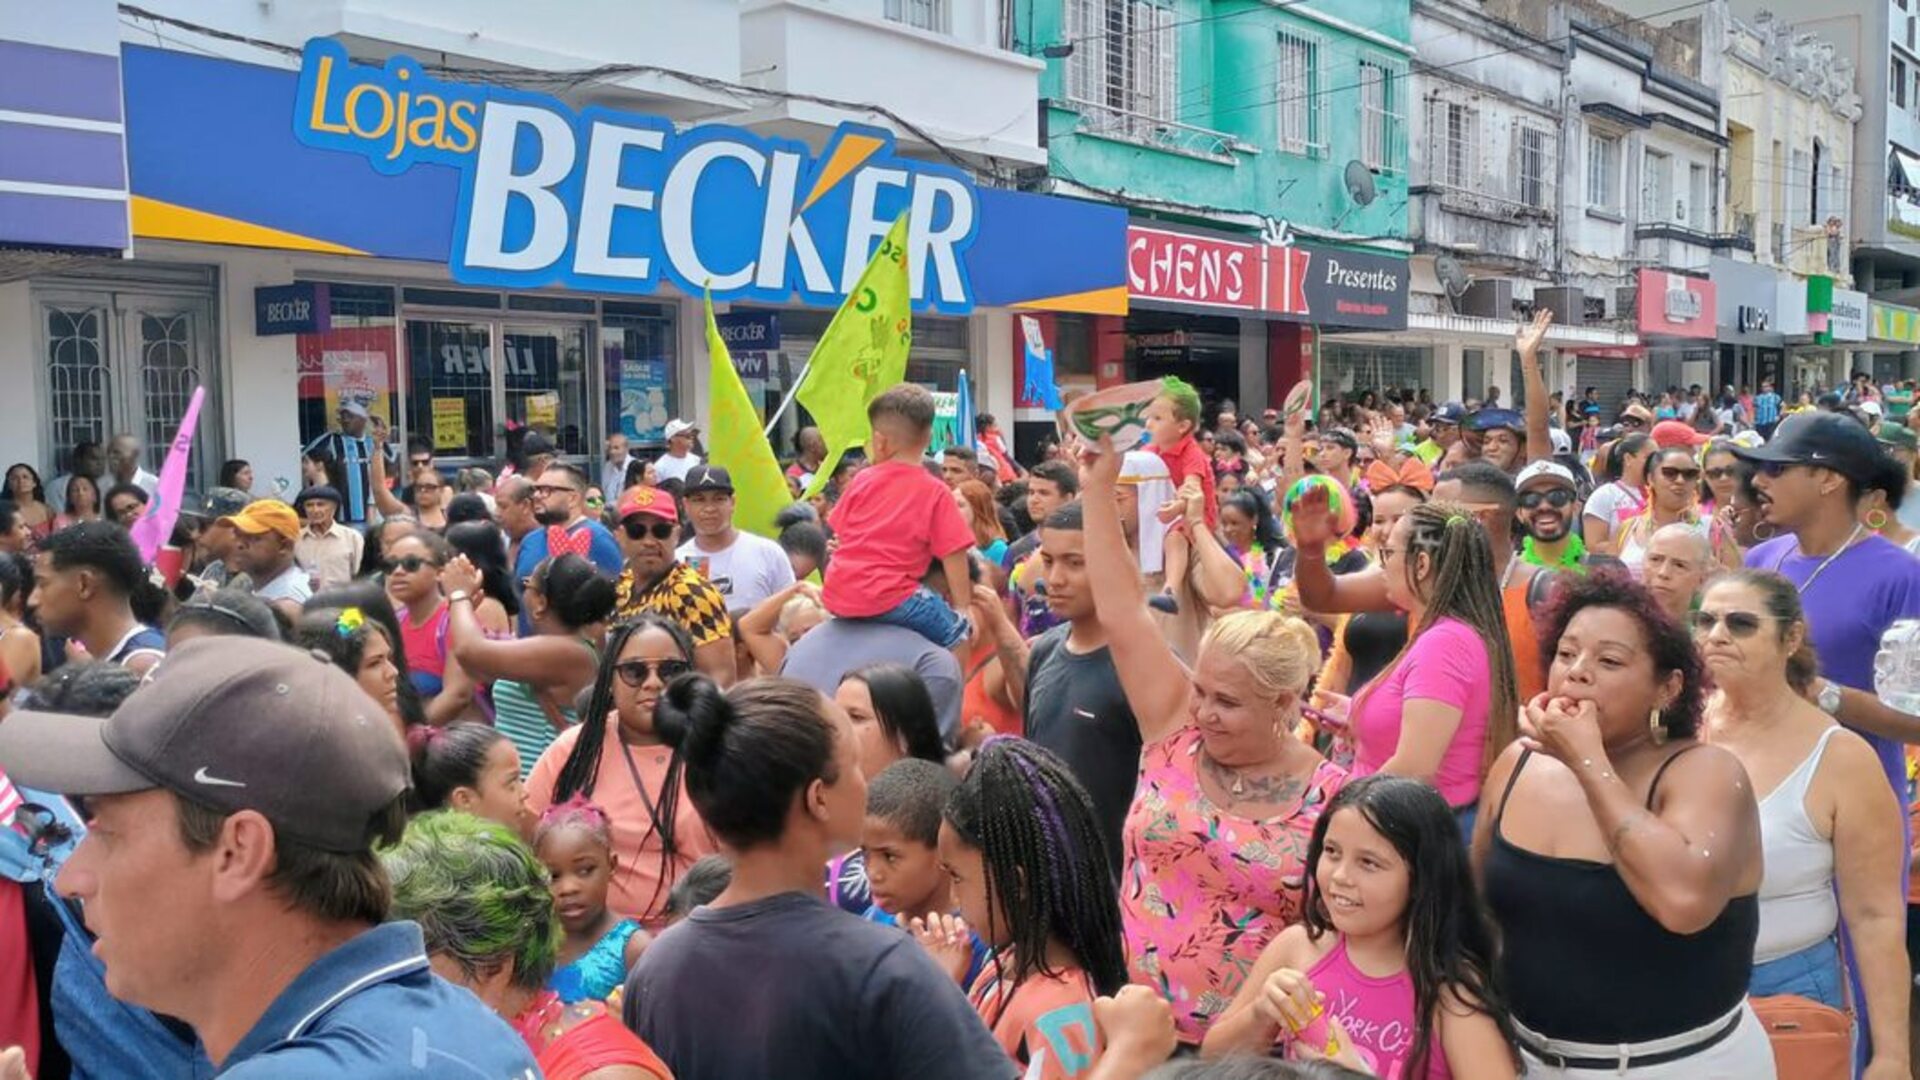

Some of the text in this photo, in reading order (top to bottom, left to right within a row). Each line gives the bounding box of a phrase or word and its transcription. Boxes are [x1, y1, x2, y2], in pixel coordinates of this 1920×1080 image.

[310, 56, 477, 160] Lojas
[464, 101, 973, 303] BECKER
[1129, 237, 1244, 302] CHENS
[1325, 259, 1397, 292] Presentes
[267, 298, 310, 323] BECKER
